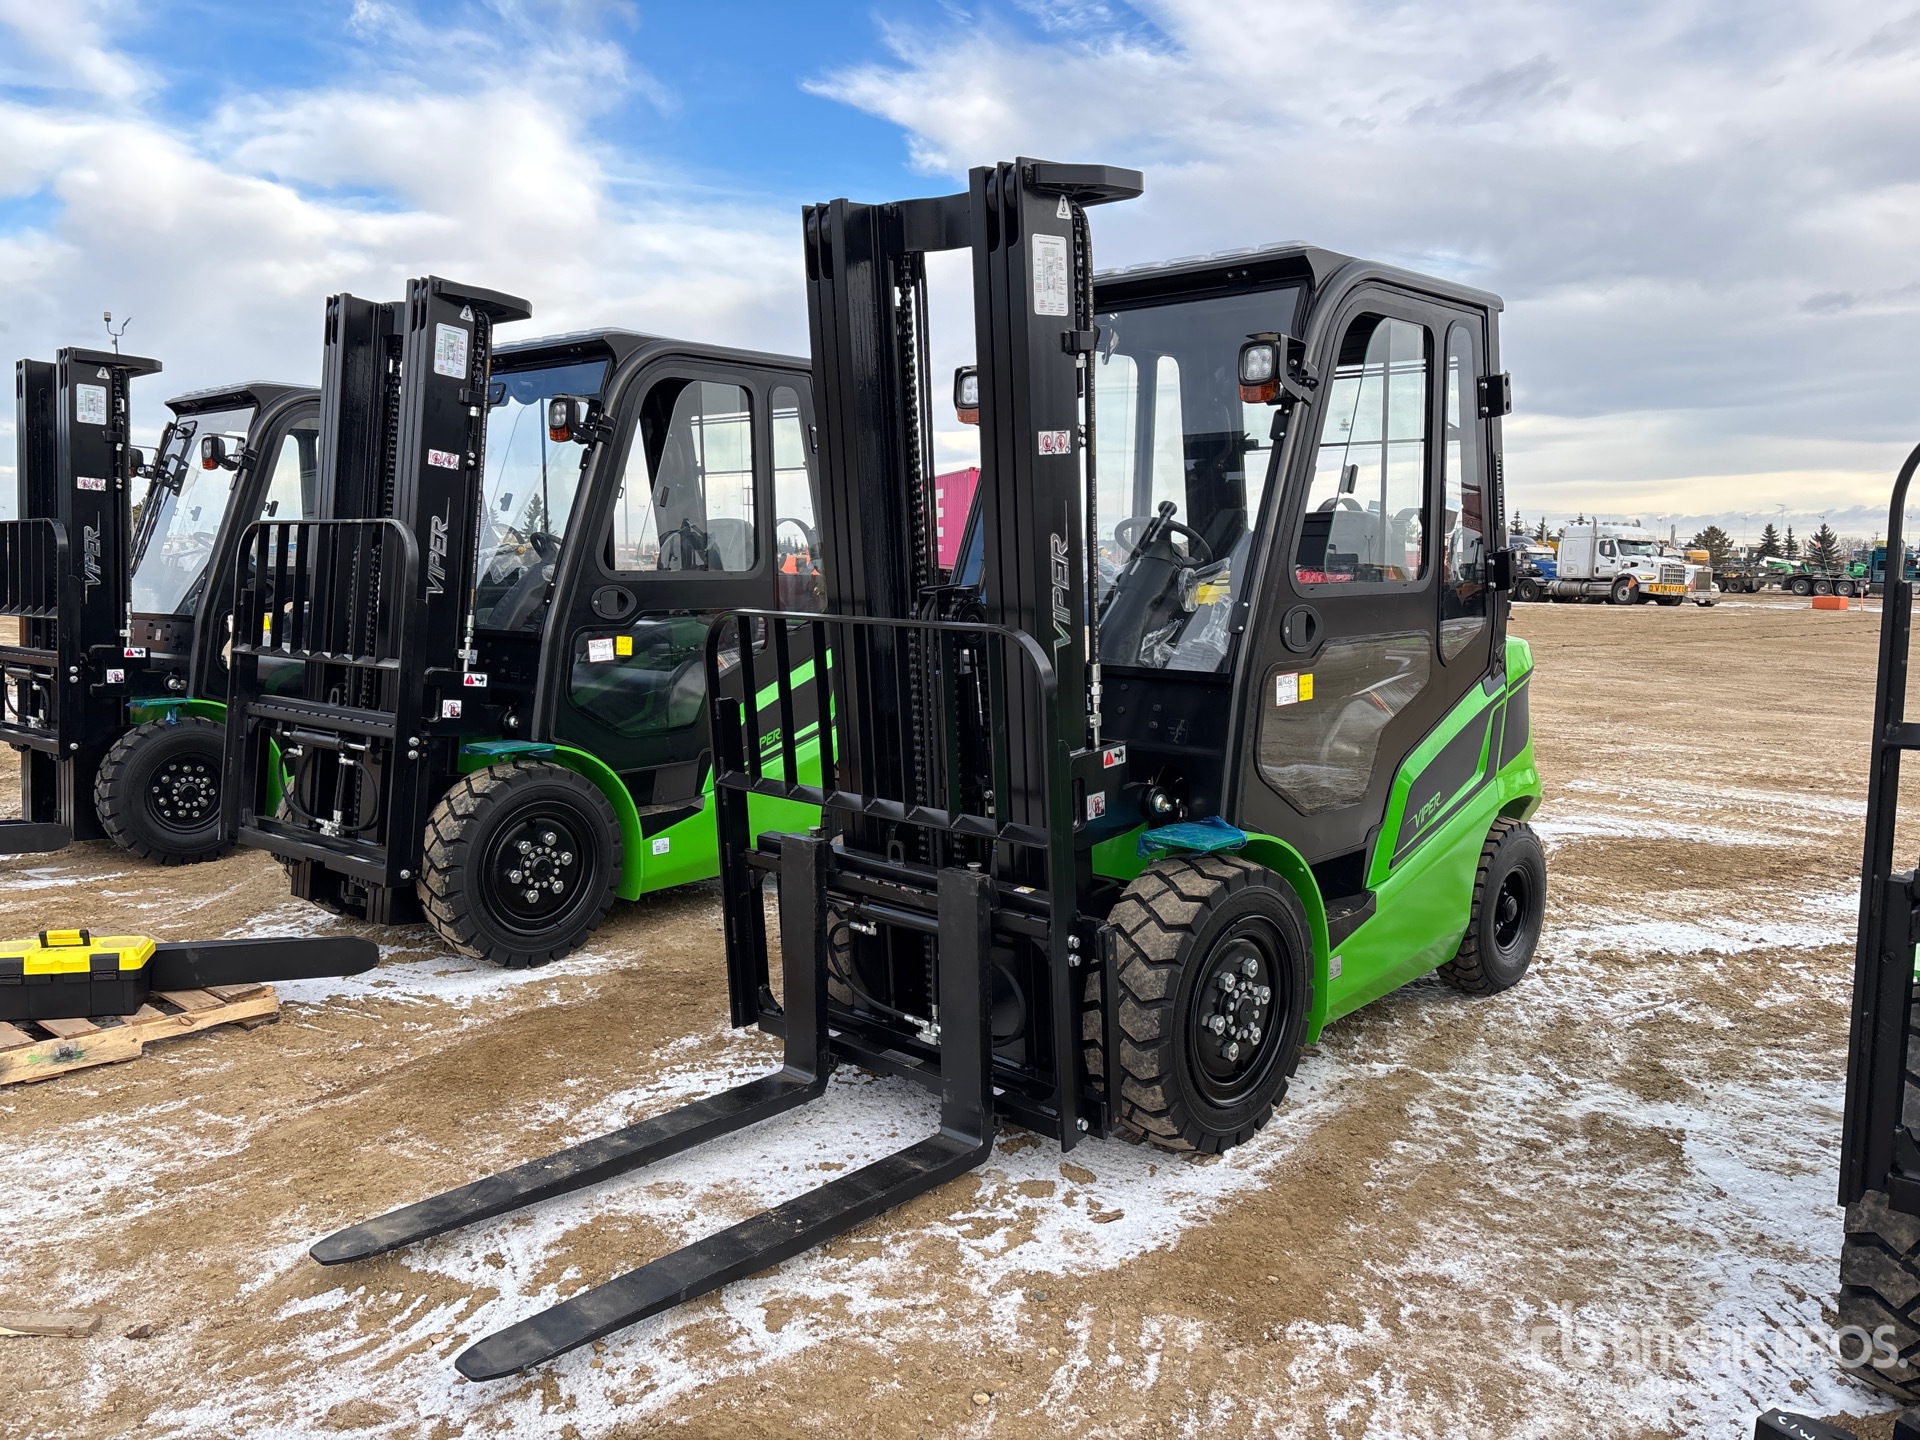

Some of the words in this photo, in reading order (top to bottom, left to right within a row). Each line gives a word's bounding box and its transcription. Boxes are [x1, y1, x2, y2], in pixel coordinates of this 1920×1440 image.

[83, 511, 101, 604] VIPER
[425, 497, 450, 604] VIPER
[1050, 500, 1072, 684] VIPER
[1406, 791, 1447, 829] VIPER
